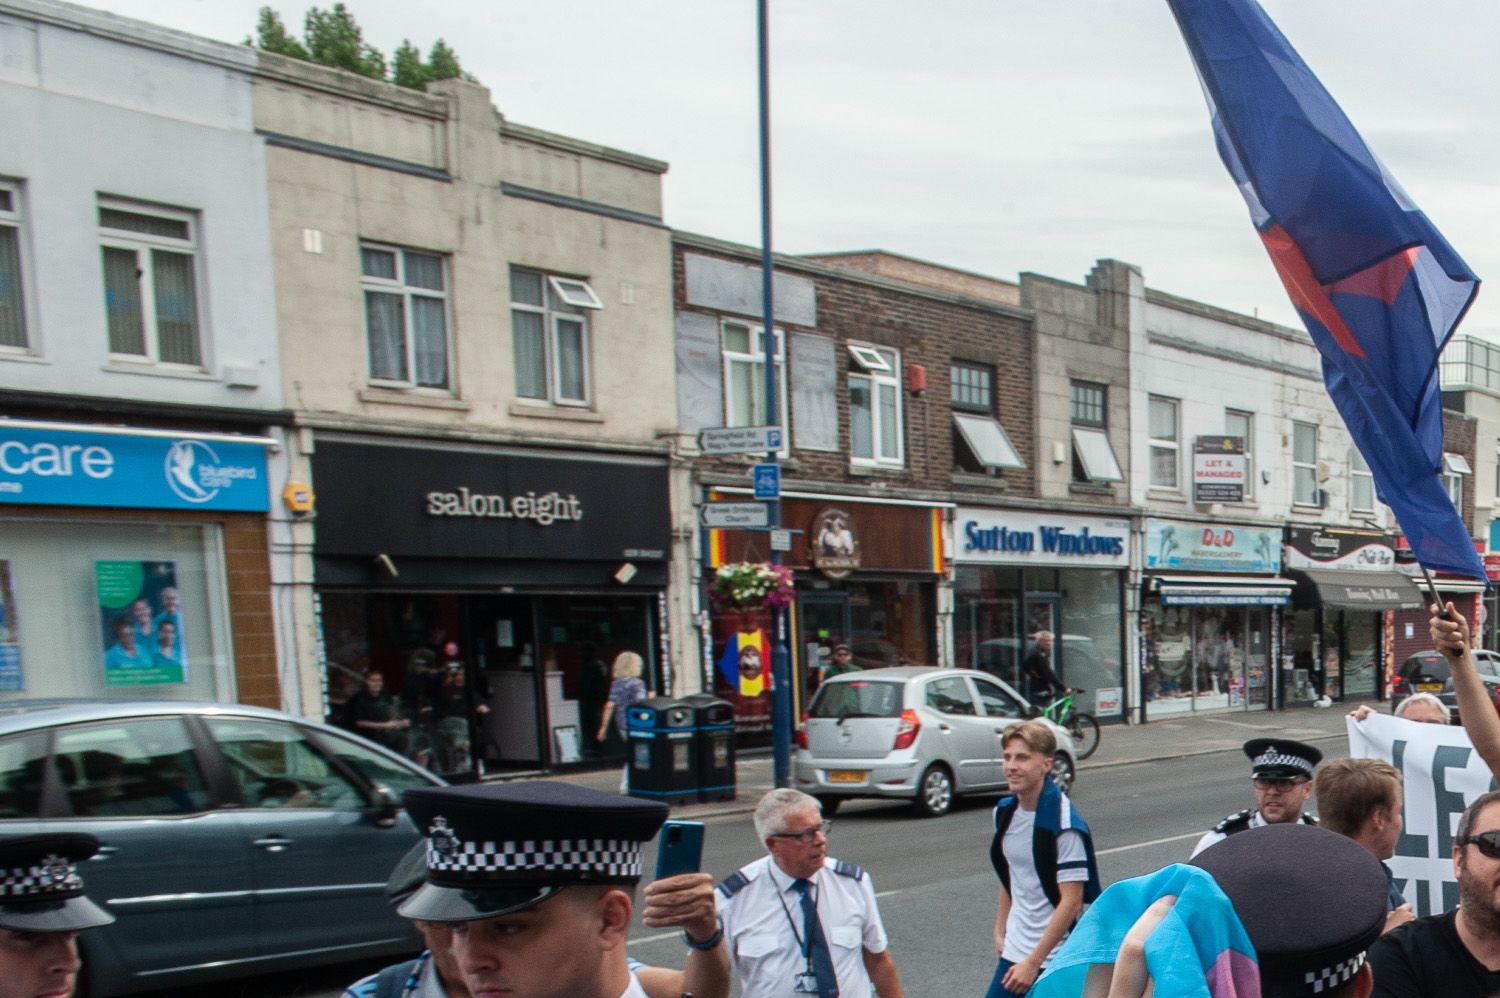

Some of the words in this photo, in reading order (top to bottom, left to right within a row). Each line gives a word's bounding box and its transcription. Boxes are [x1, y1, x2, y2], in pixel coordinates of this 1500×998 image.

[0, 441, 114, 479] care
[1195, 470, 1243, 479] MANAGED
[1205, 459, 1223, 467] LET
[426, 486, 584, 526] salon.eight
[965, 520, 1035, 553] Sutton
[1039, 525, 1123, 556] Windows
